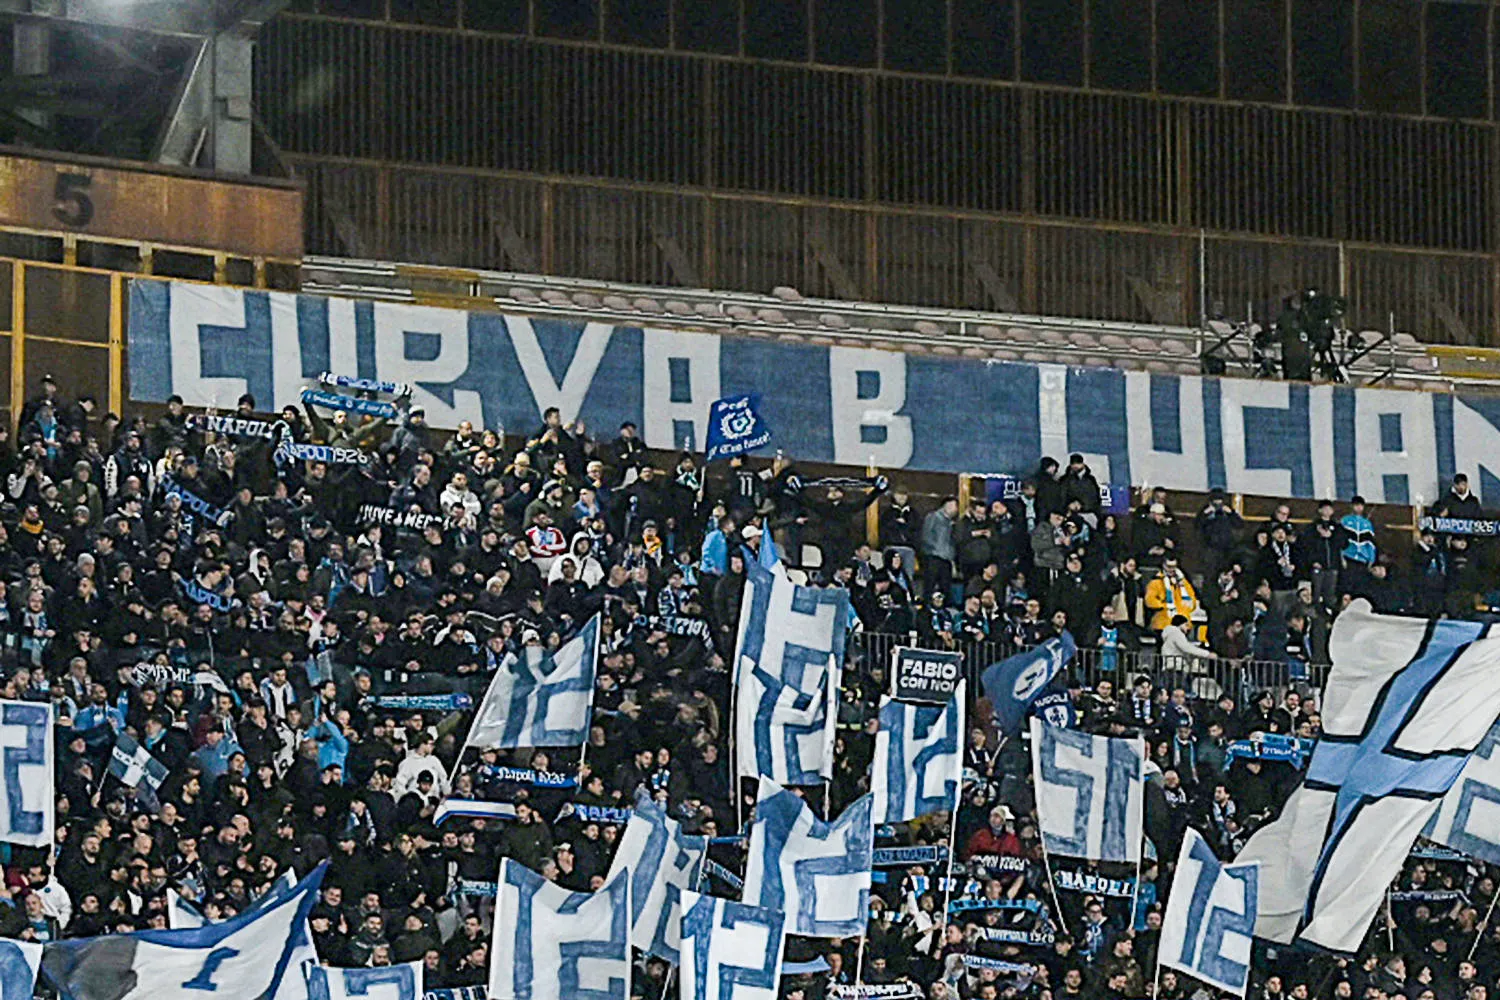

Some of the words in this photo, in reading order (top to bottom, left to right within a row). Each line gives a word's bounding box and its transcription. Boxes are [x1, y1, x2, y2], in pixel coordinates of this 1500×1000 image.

[52, 173, 93, 228] 5
[170, 281, 721, 453] CURVA
[830, 346, 915, 468] B
[207, 416, 272, 439] NAPOL
[902, 659, 958, 681] FABIO
[900, 678, 928, 691] CON
[931, 681, 956, 694] NOI
[1060, 868, 1132, 896] NAPOLI
[1178, 835, 1260, 989] 12
